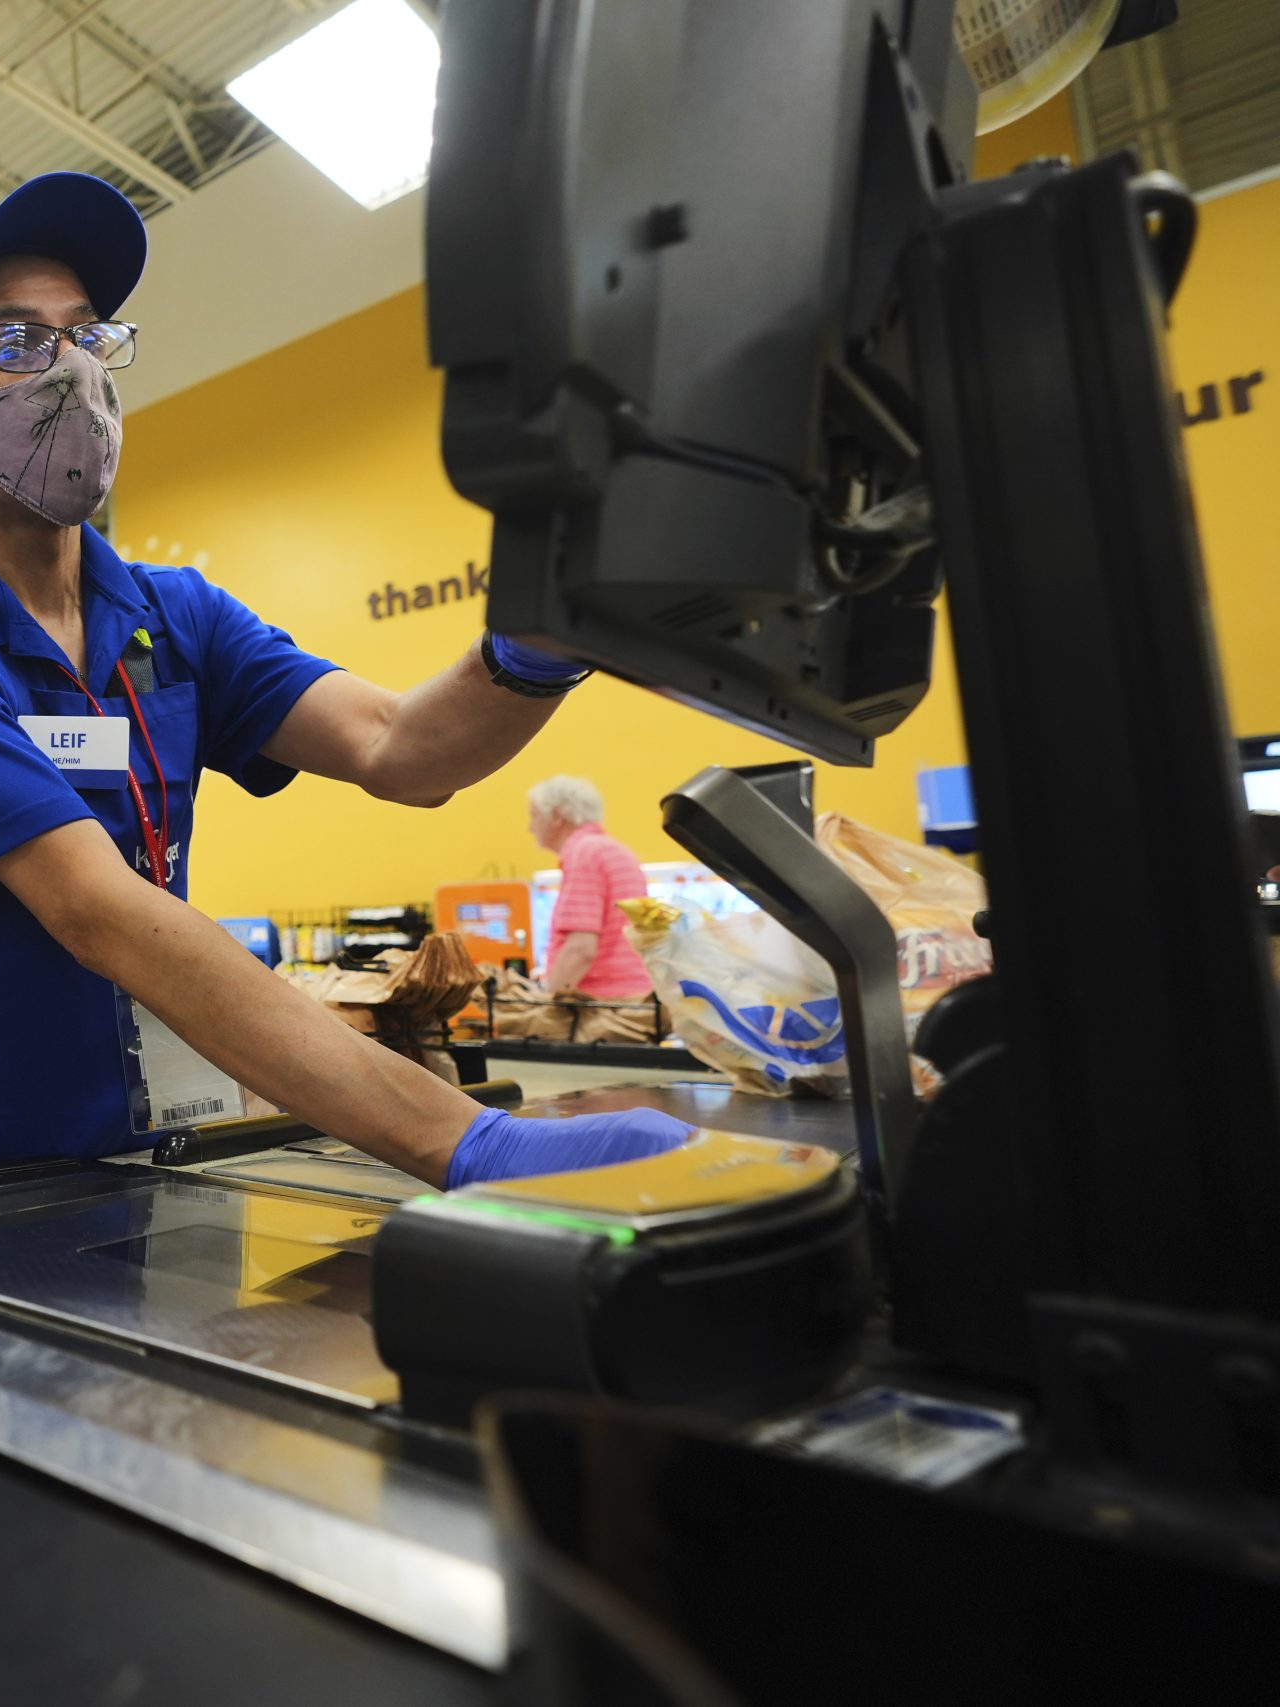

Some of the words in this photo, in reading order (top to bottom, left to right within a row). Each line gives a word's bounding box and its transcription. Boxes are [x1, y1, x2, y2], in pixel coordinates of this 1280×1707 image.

[368, 561, 490, 621] thank
[50, 732, 87, 749] LEIF
[52, 757, 81, 766] HE/HIM
[135, 829, 179, 883] Kger
